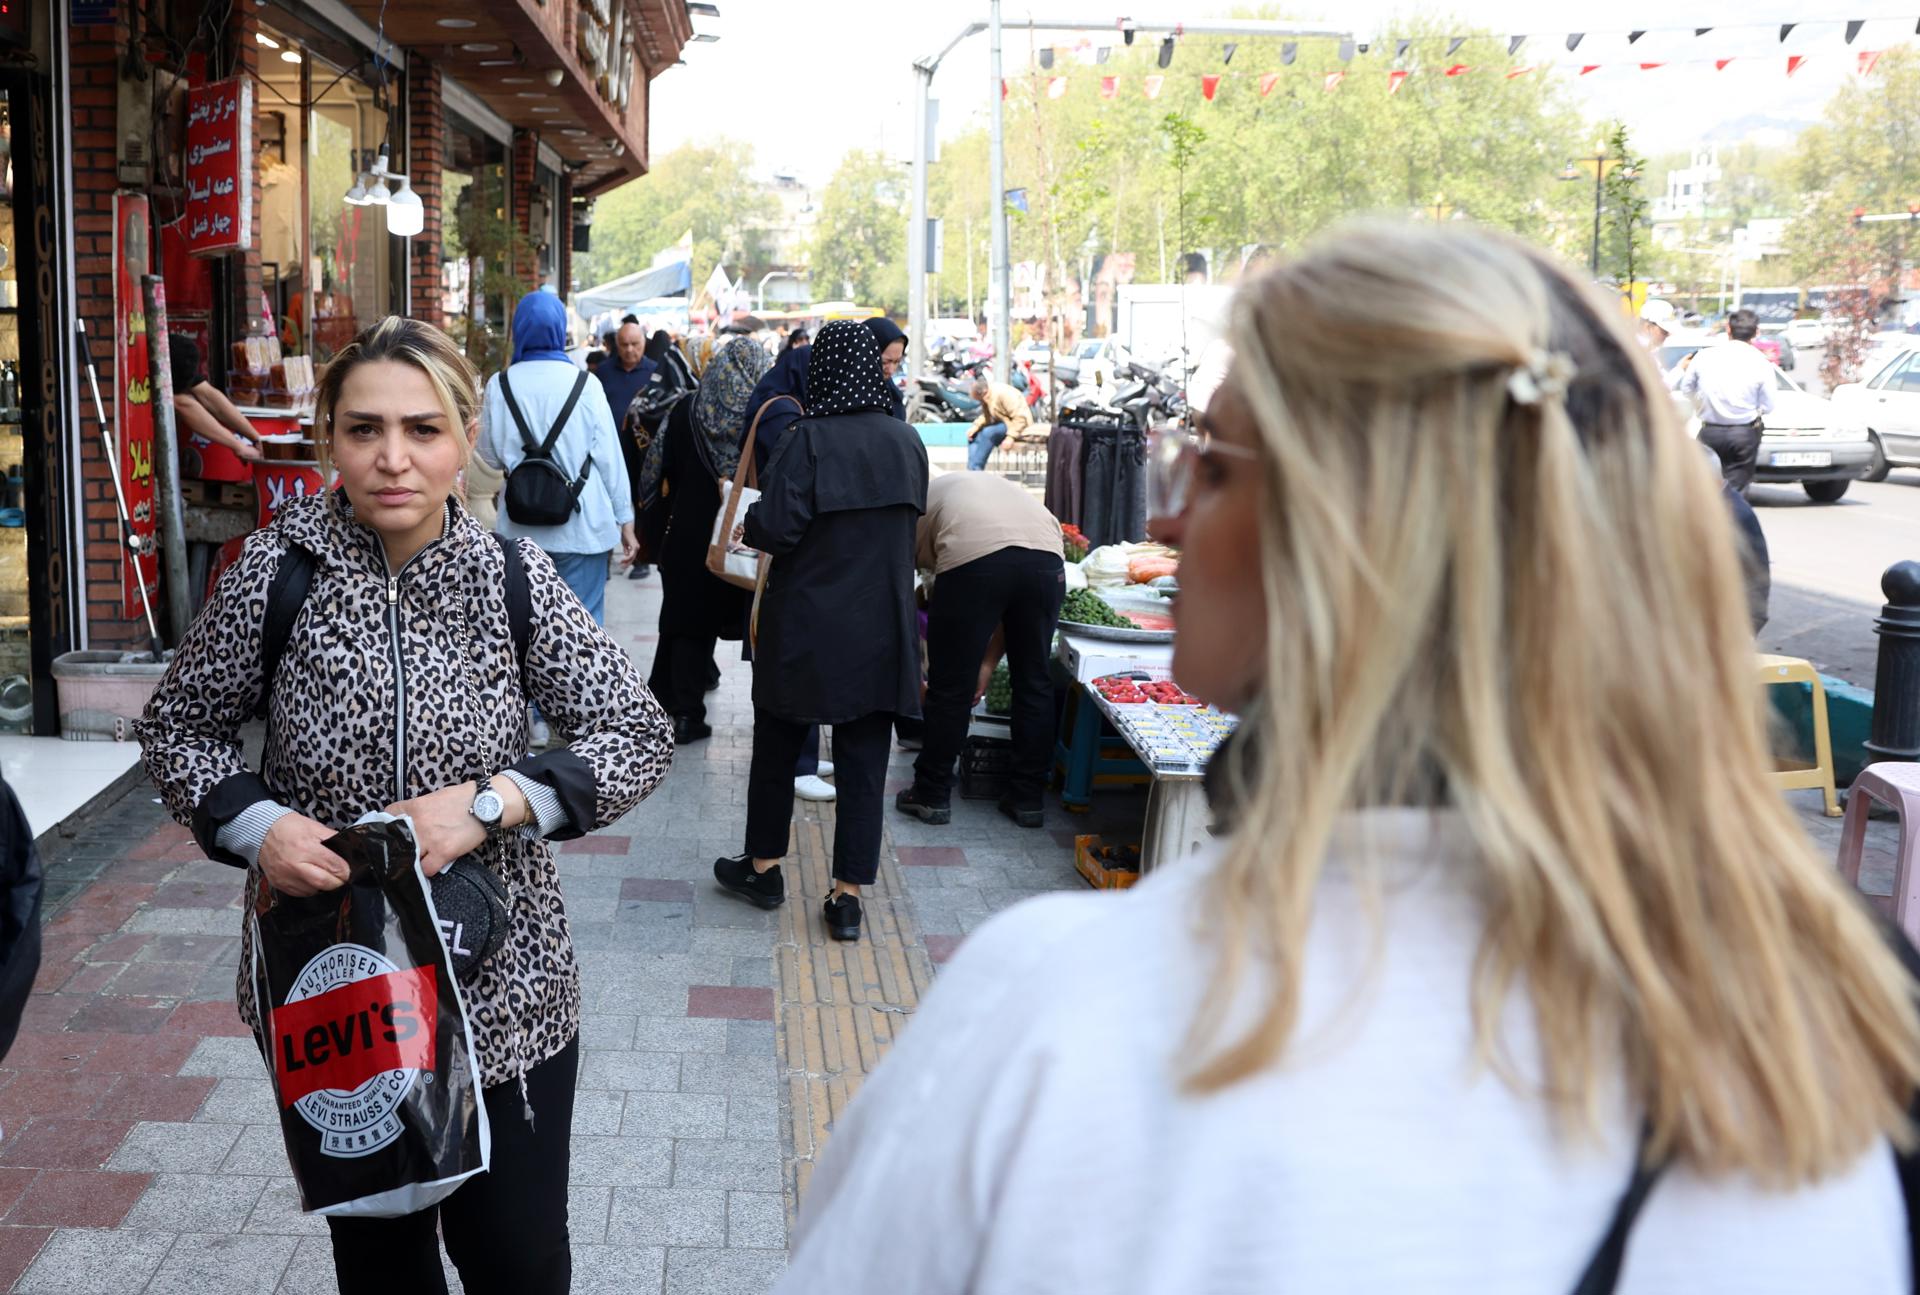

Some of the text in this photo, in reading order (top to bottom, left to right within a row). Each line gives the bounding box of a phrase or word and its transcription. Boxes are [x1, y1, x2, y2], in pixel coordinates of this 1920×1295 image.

[188, 95, 235, 128] مرکز پخش
[188, 175, 233, 203] عمه لیلا
[191, 212, 231, 239] چهار فصل
[129, 440, 151, 486] لیلا
[300, 954, 377, 998] AUTHORISED
[316, 968, 354, 992] DEALER
[304, 1069, 405, 1127] LEVI STRAUSS & CO
[363, 1074, 387, 1103] QUALITY
